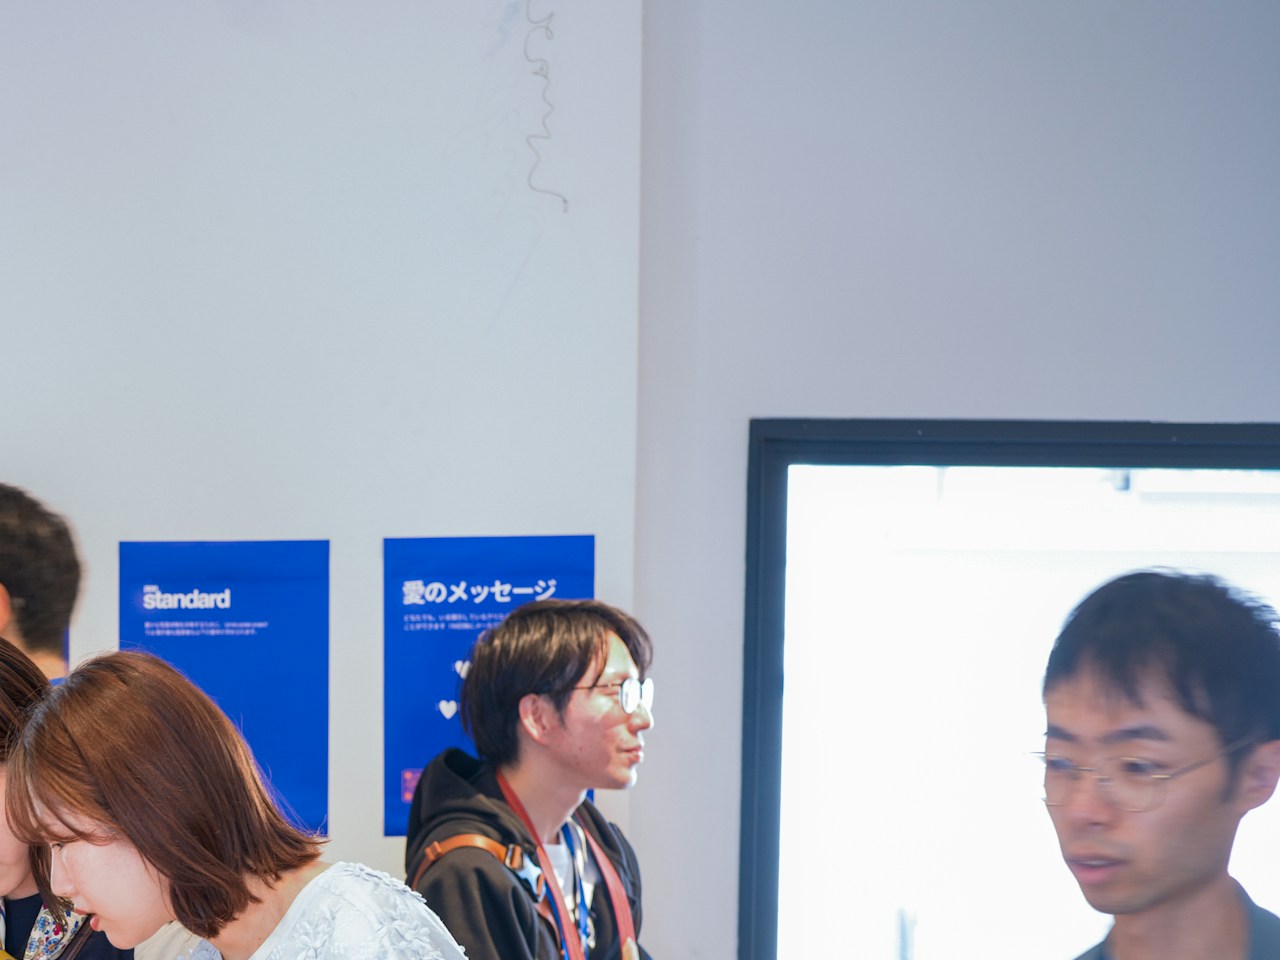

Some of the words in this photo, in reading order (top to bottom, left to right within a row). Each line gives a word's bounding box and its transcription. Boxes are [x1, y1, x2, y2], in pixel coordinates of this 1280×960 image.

[143, 588, 231, 609] standard
[402, 580, 557, 605] 愛のメッセージ
